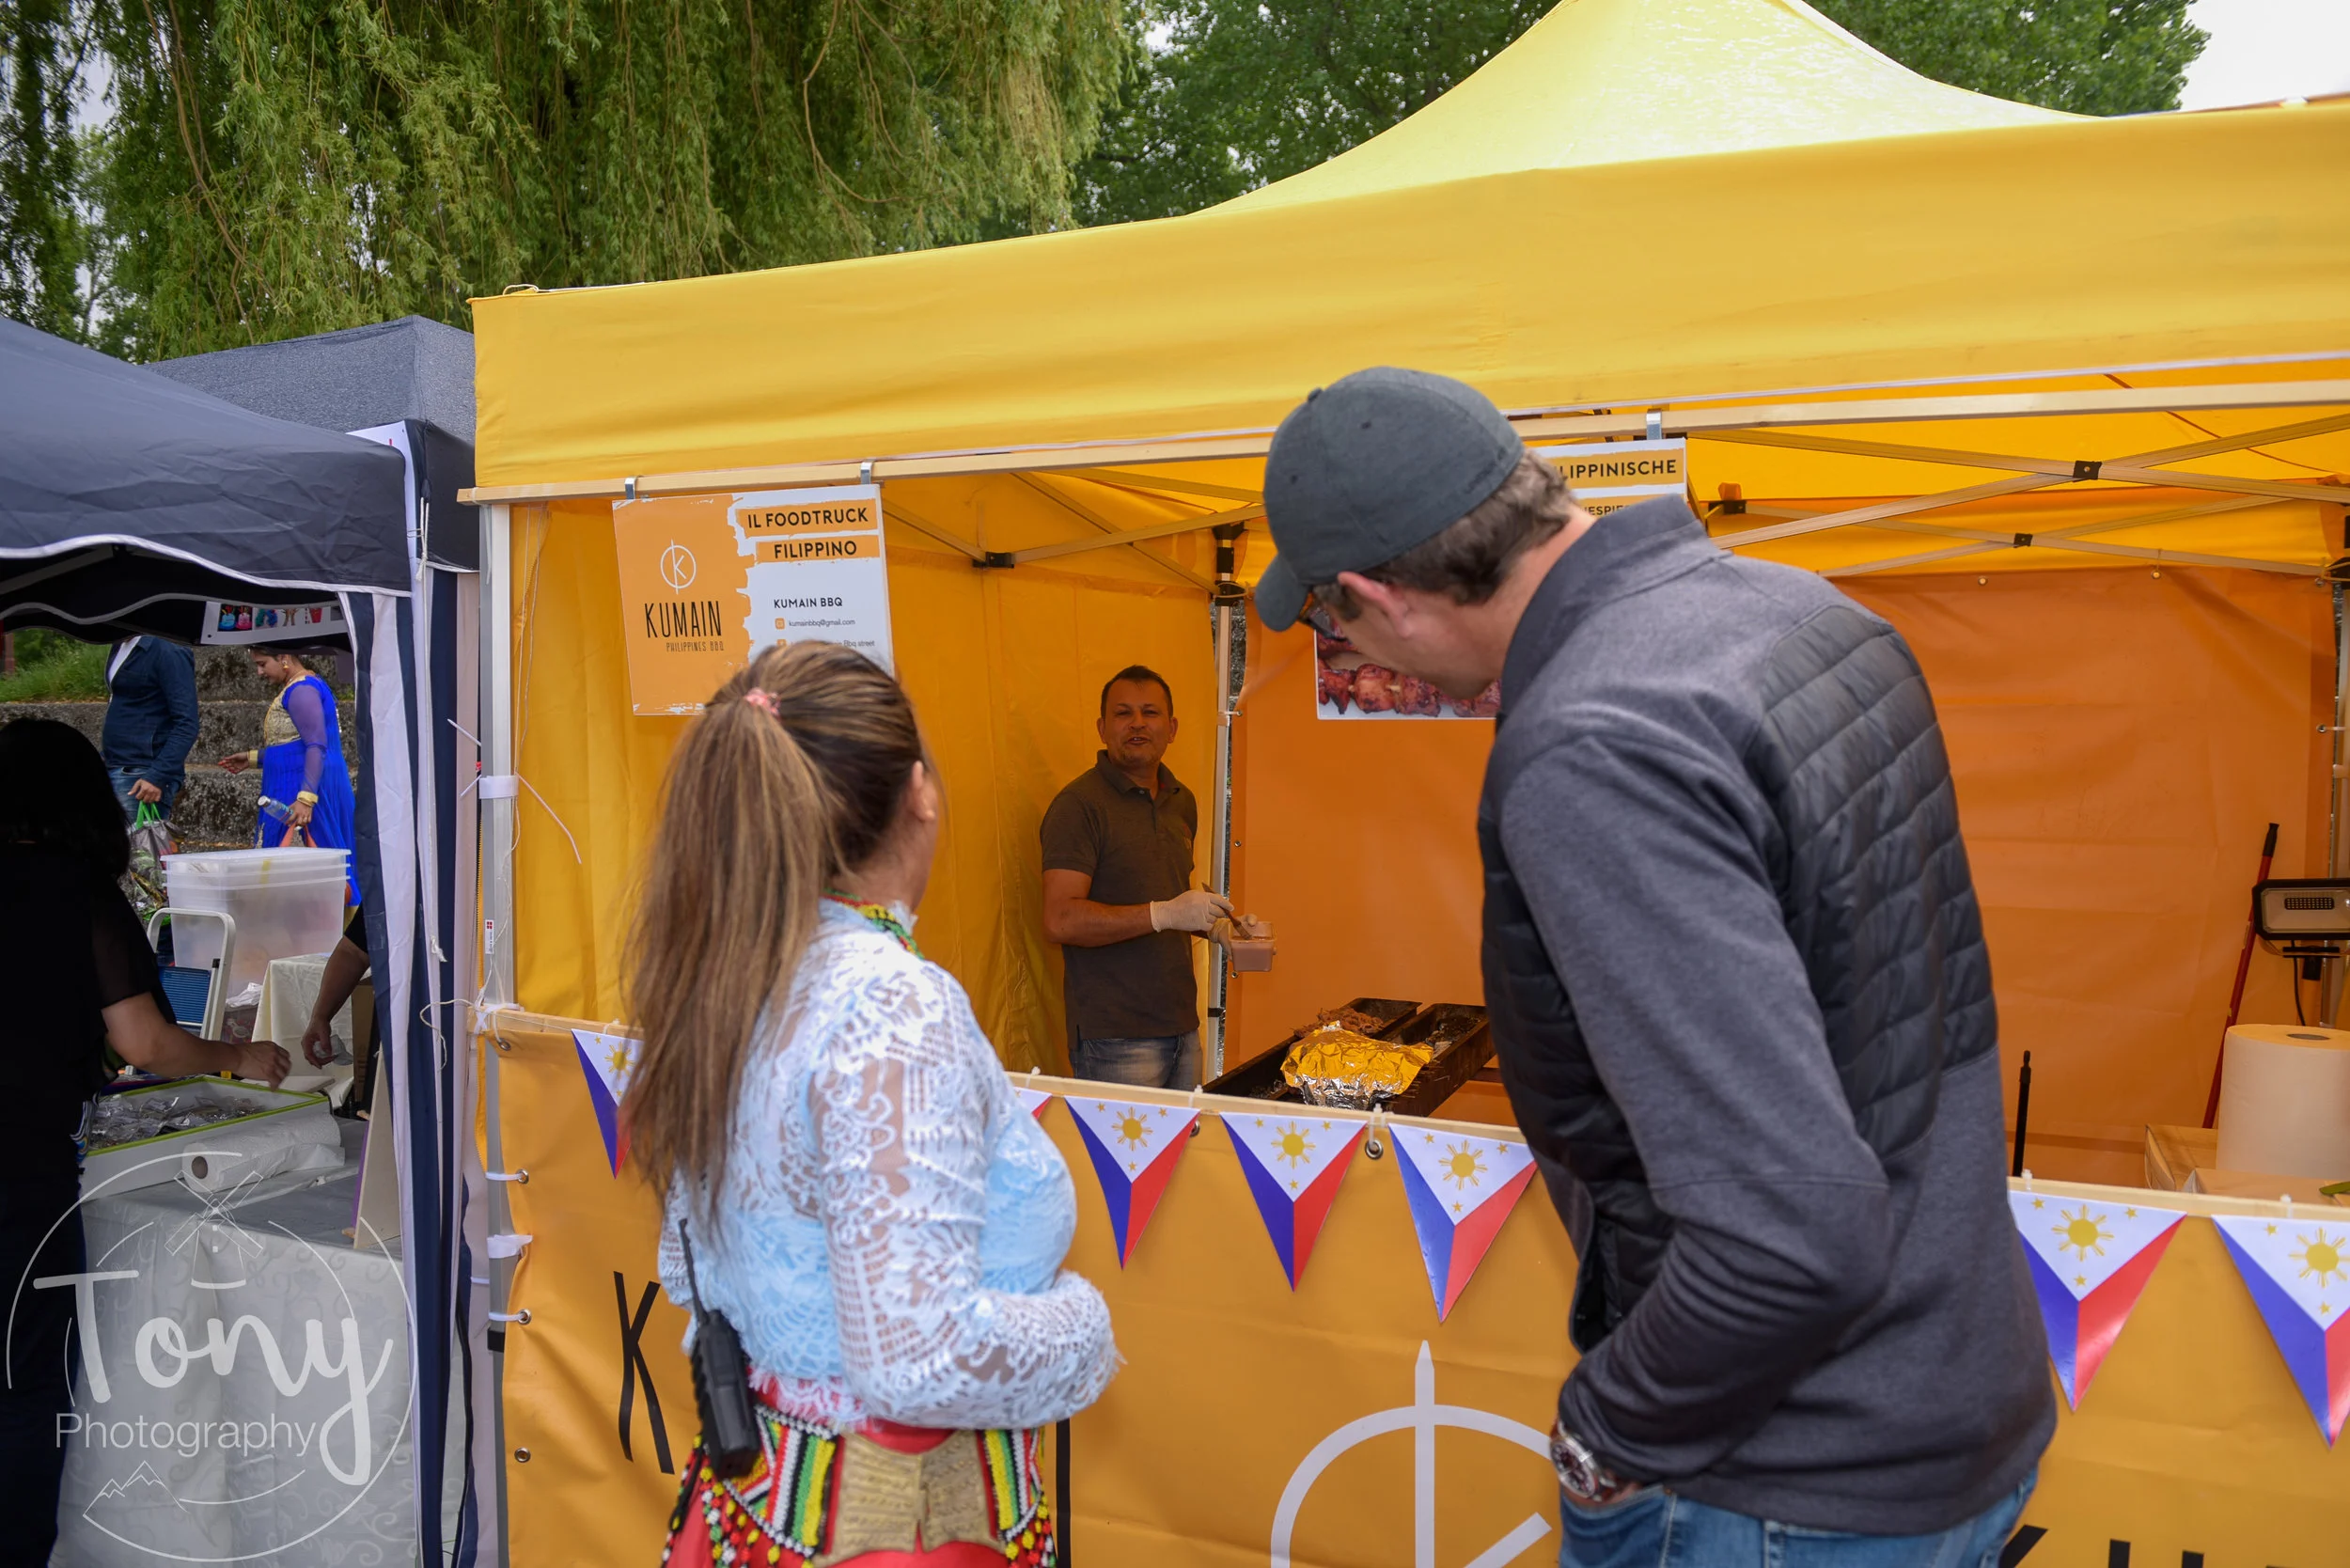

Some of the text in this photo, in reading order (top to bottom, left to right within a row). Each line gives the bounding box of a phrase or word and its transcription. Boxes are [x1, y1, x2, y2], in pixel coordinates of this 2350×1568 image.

[1554, 460, 1677, 478] LIPPINISCHE
[747, 508, 869, 528] IL FOODTRUCK
[774, 541, 857, 558] FILIPPINO
[774, 597, 843, 609] KUMAIN BBQ
[645, 601, 722, 638] KUMAIN
[789, 618, 855, 628] kumainbbq@gmail.com
[666, 640, 725, 652] PHILIPPINES BBQ
